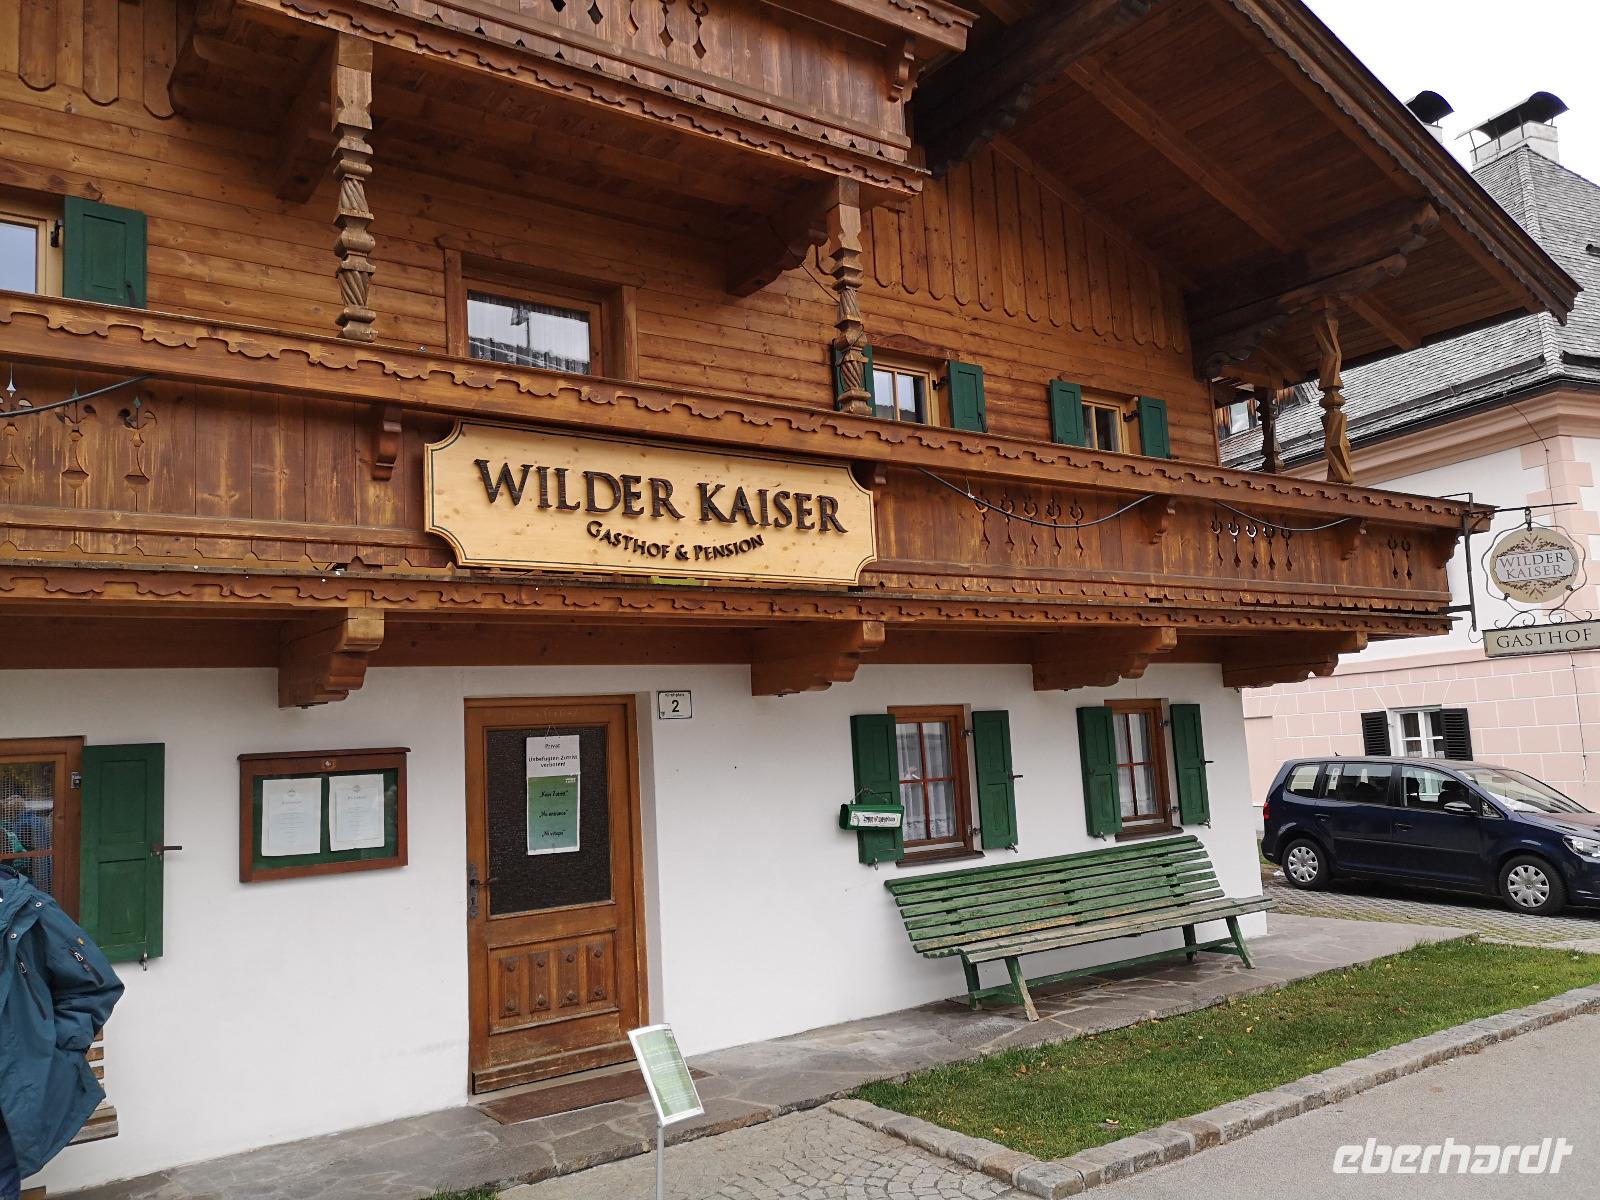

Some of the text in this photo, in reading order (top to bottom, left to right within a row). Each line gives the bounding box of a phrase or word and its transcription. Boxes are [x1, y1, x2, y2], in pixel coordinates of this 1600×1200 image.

[473, 458, 849, 534] WILDER KAISER
[586, 520, 764, 561] GASTHOF & PENSION
[1500, 552, 1566, 569] WILDER
[1506, 564, 1563, 579] KAISER
[1496, 628, 1592, 648] GASTHOF
[671, 699, 680, 713] 2
